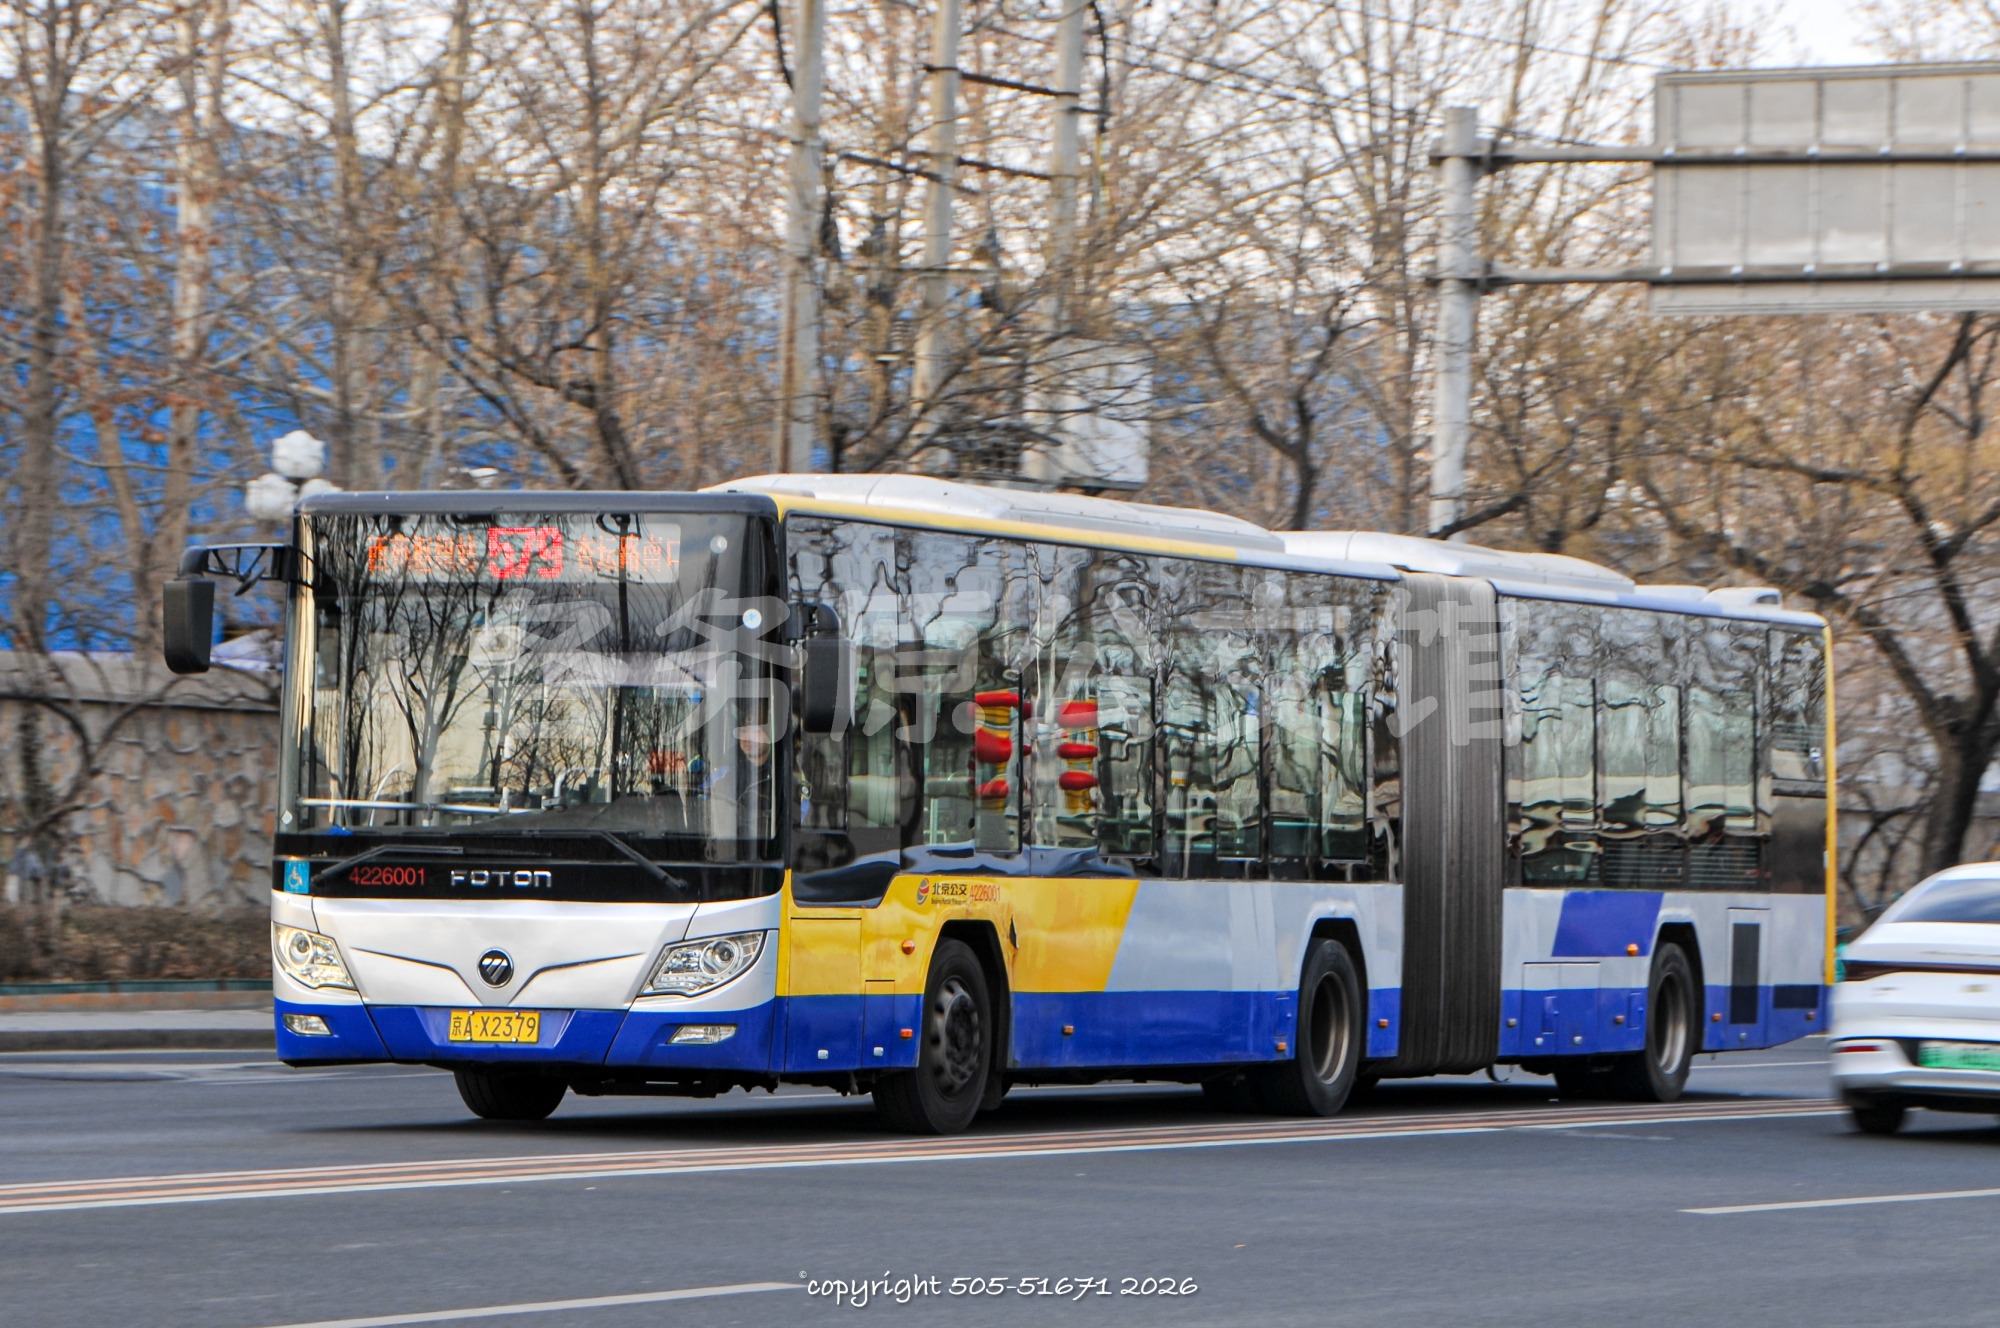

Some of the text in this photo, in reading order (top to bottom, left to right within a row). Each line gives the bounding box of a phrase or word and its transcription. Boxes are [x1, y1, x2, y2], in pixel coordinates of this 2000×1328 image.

[487, 526, 563, 579] 579
[349, 867, 426, 886] 4226001
[450, 869, 552, 888] FOTON
[932, 882, 968, 896] 北京公交
[969, 884, 1001, 902] 4226001
